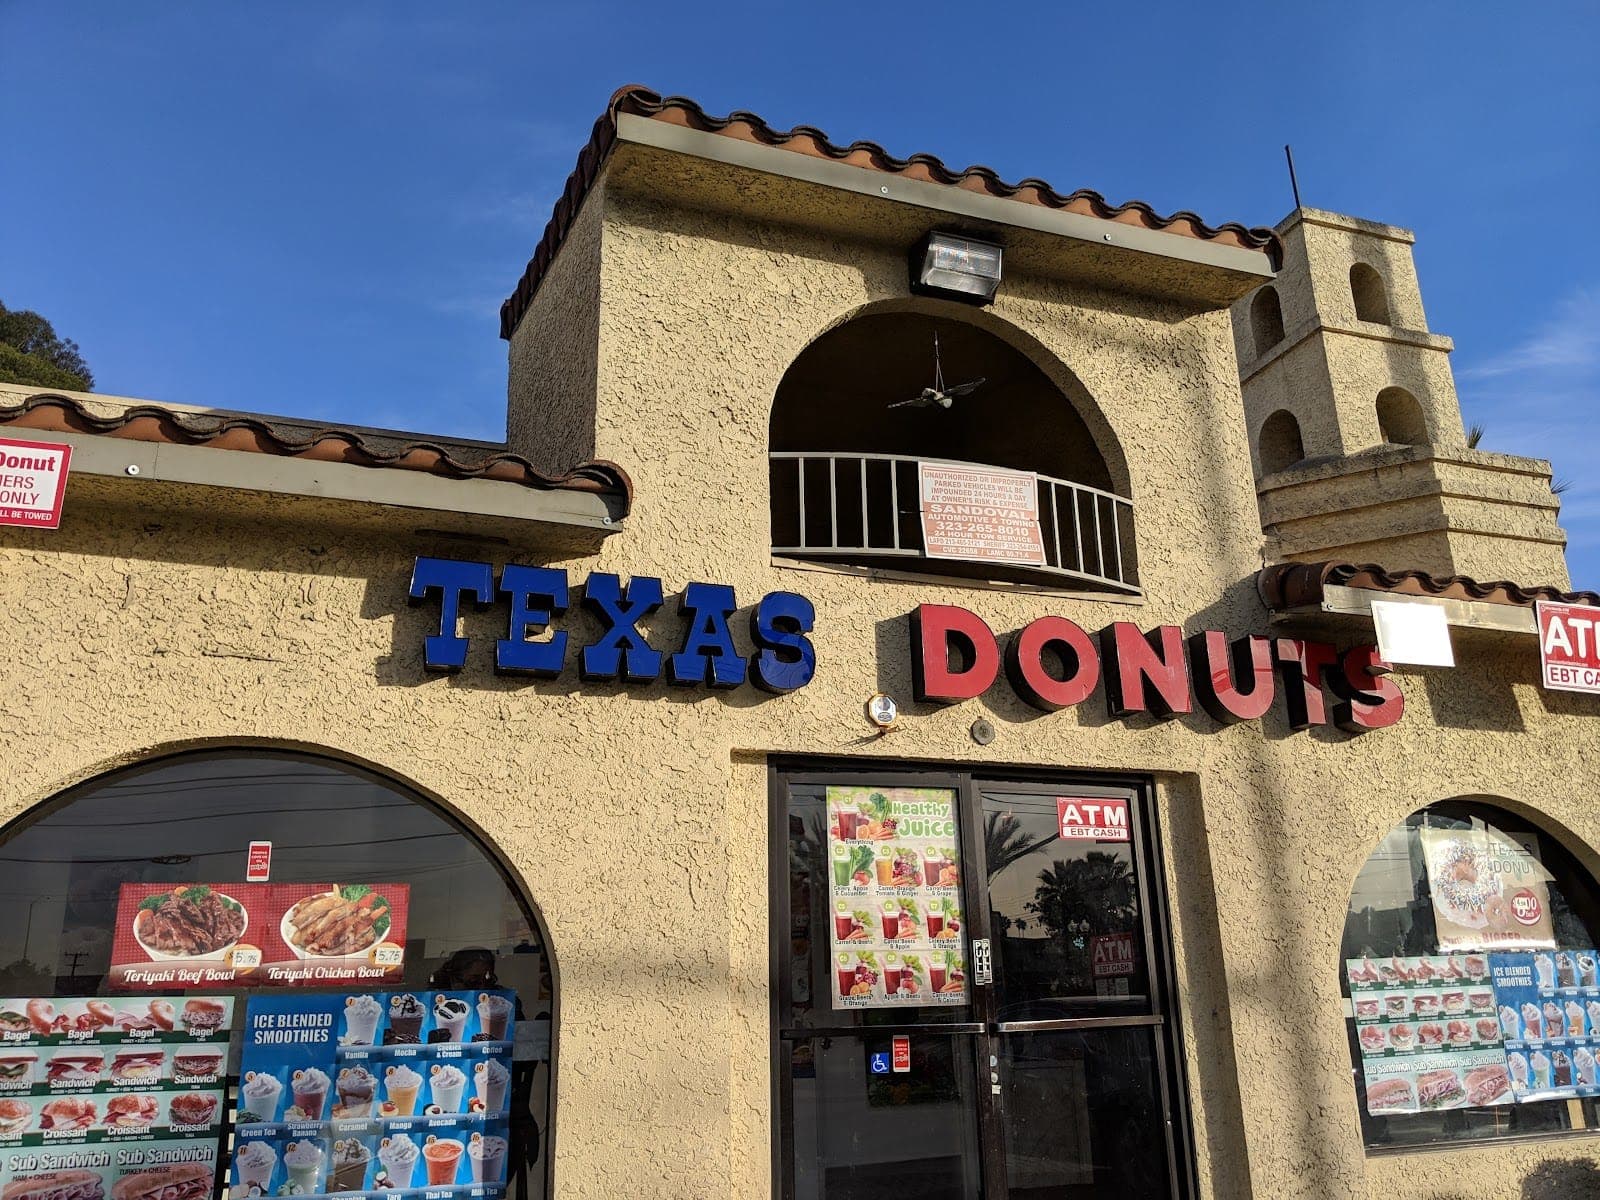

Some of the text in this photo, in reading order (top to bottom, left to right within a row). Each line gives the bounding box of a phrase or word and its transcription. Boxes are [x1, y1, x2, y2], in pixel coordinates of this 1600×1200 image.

[924, 472, 978, 482] UNAUTHORIZED
[934, 480, 962, 488] PARKED
[964, 482, 996, 490] VEHICLES
[0, 490, 40, 506] ONLY
[932, 488, 972, 496] IMPOUNDED
[984, 492, 1006, 500] HOURS
[24, 512, 52, 520] TOWED
[930, 504, 1030, 520] SANDOVAL
[928, 513, 989, 524] AUTOMOTIVE
[1002, 518, 1035, 528] TOWING
[936, 521, 1029, 536] 323-265-8010
[997, 535, 1032, 543] SERVICE
[408, 556, 1405, 729] TEXAS DONUTS
[1544, 615, 1600, 660] AT
[1550, 667, 1579, 684] EBT
[892, 802, 949, 818] Healthy
[1062, 804, 1126, 826] ATM
[899, 818, 956, 837] Juice
[1070, 828, 1090, 836] EBT
[1094, 940, 1132, 962] ATM
[1112, 963, 1130, 973] CASH
[1494, 966, 1532, 977] ICE BLENDED
[124, 968, 236, 985] Teriyaki Beef Bowl
[268, 966, 386, 982] Teriyaki Chicken Bowl
[1496, 976, 1532, 987] SMOOTHIES
[254, 1013, 333, 1028] ICE BLENDED
[4, 1031, 31, 1041] Bagel
[68, 1030, 94, 1040] Bagel
[130, 1028, 154, 1038] Bagel
[190, 1027, 214, 1037] Bagel
[254, 1028, 329, 1044] SMOOTHIES
[394, 1048, 416, 1056] Mocha
[482, 1046, 502, 1054] Coffee
[345, 1051, 368, 1060] Vanilla
[1377, 1062, 1412, 1073] Sandwich
[50, 1078, 96, 1088] Sandwich
[112, 1075, 158, 1086] Sandwich
[174, 1074, 217, 1084] Sandwich
[170, 1122, 210, 1132] Croissant
[288, 1122, 323, 1130] Strawberry
[339, 1123, 368, 1131] Caramel
[390, 1122, 412, 1130] Mango
[428, 1119, 456, 1127] Avocado
[44, 1128, 88, 1138] Croissant
[108, 1126, 150, 1135] Croissant
[242, 1129, 262, 1137] Green
[117, 1145, 213, 1165] Sub Sandwich
[9, 1150, 110, 1171] Sub Sandwich
[426, 1190, 453, 1200] Thai Tea
[486, 1188, 498, 1196] Tea
